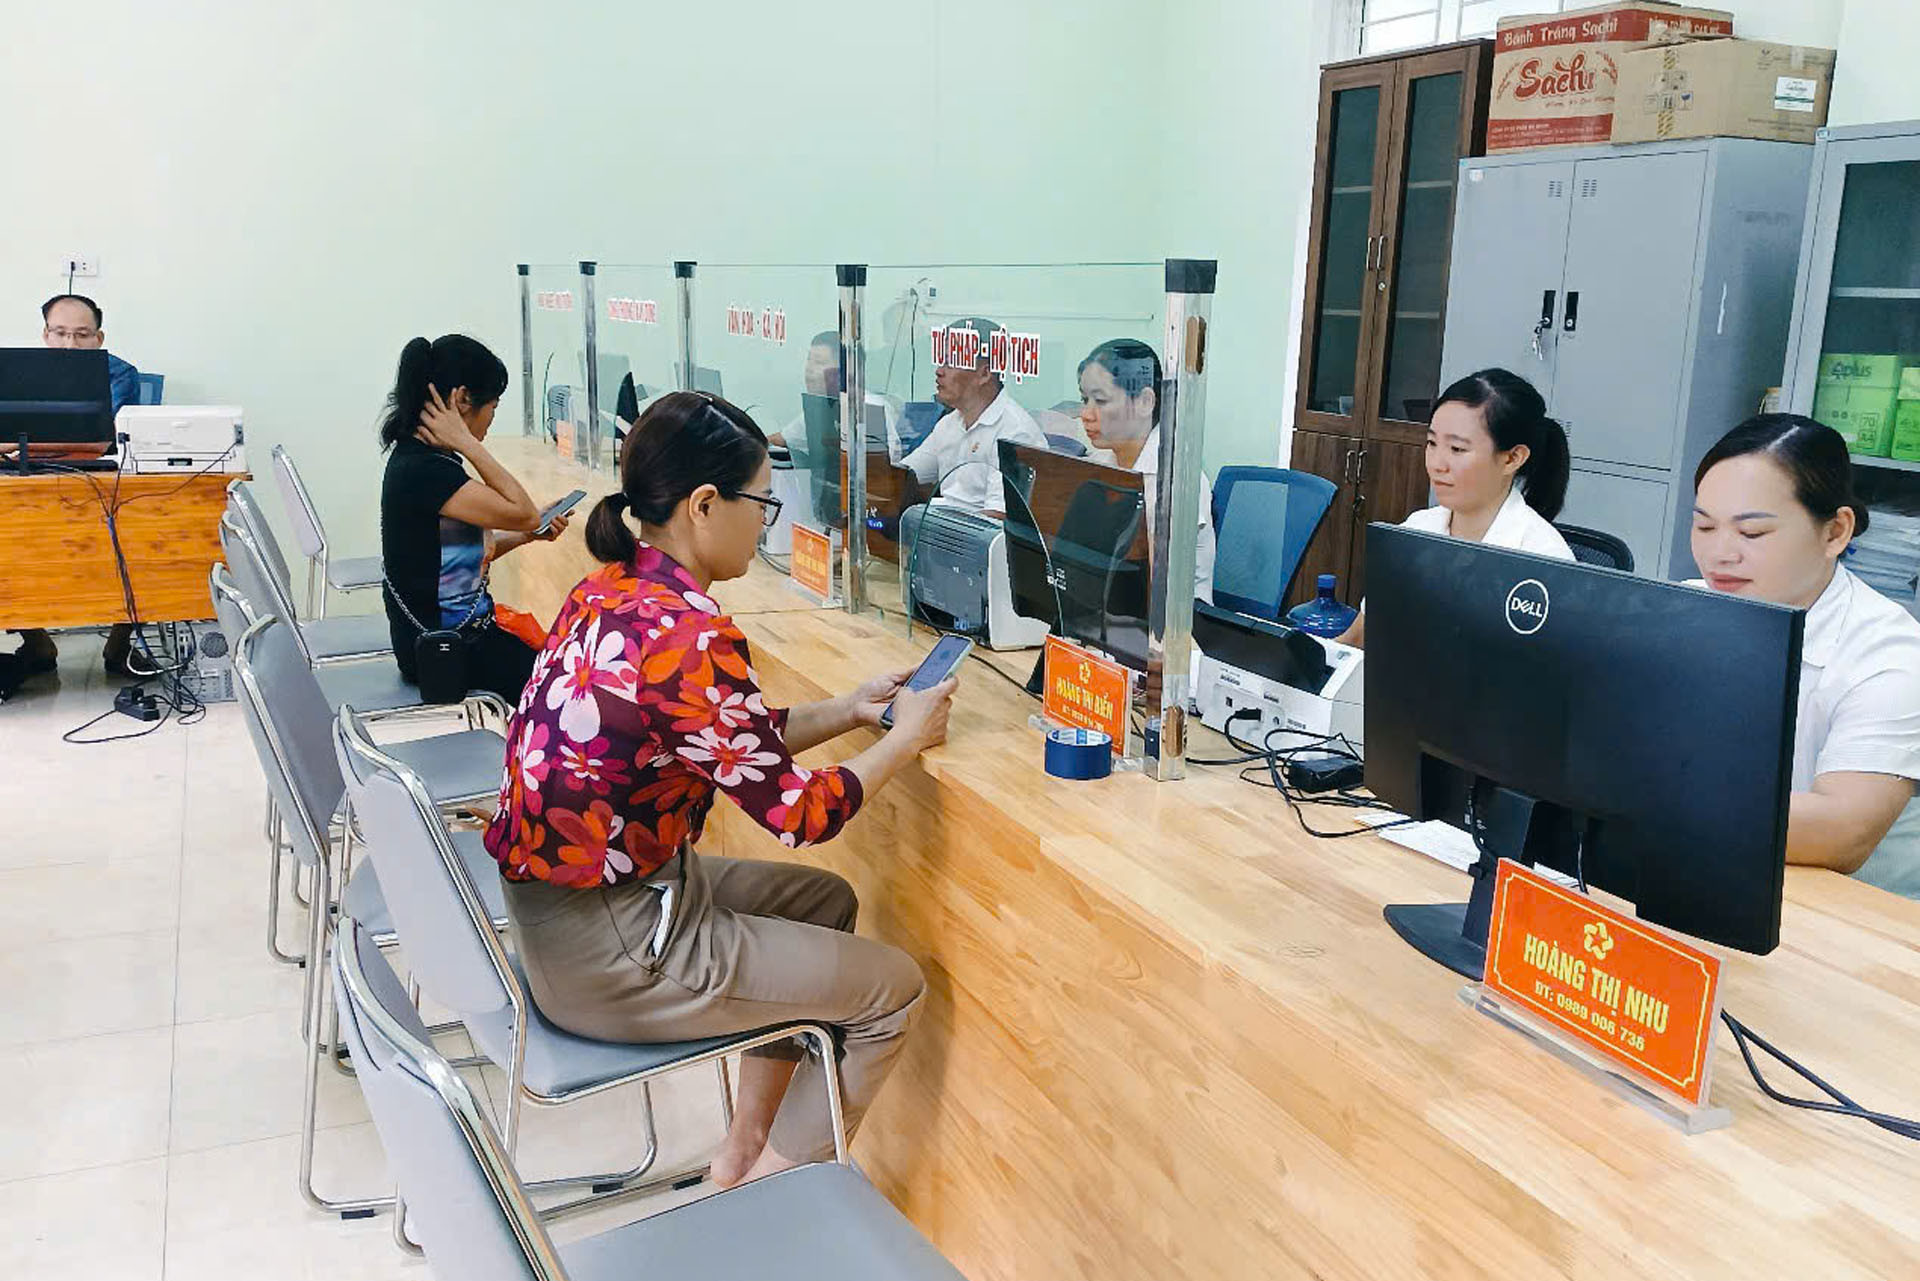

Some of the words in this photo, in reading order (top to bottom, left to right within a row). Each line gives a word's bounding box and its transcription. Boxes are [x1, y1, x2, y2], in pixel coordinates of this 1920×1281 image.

[932, 328, 946, 364] TƯ
[950, 322, 979, 368] PHÁP
[991, 327, 1007, 380] HỘ
[1009, 336, 1039, 383] TỊCH
[1511, 597, 1543, 618] DELL
[1523, 933, 1587, 992] HOÀNG
[1591, 966, 1622, 1016] THỊ
[1624, 985, 1670, 1034] NHU
